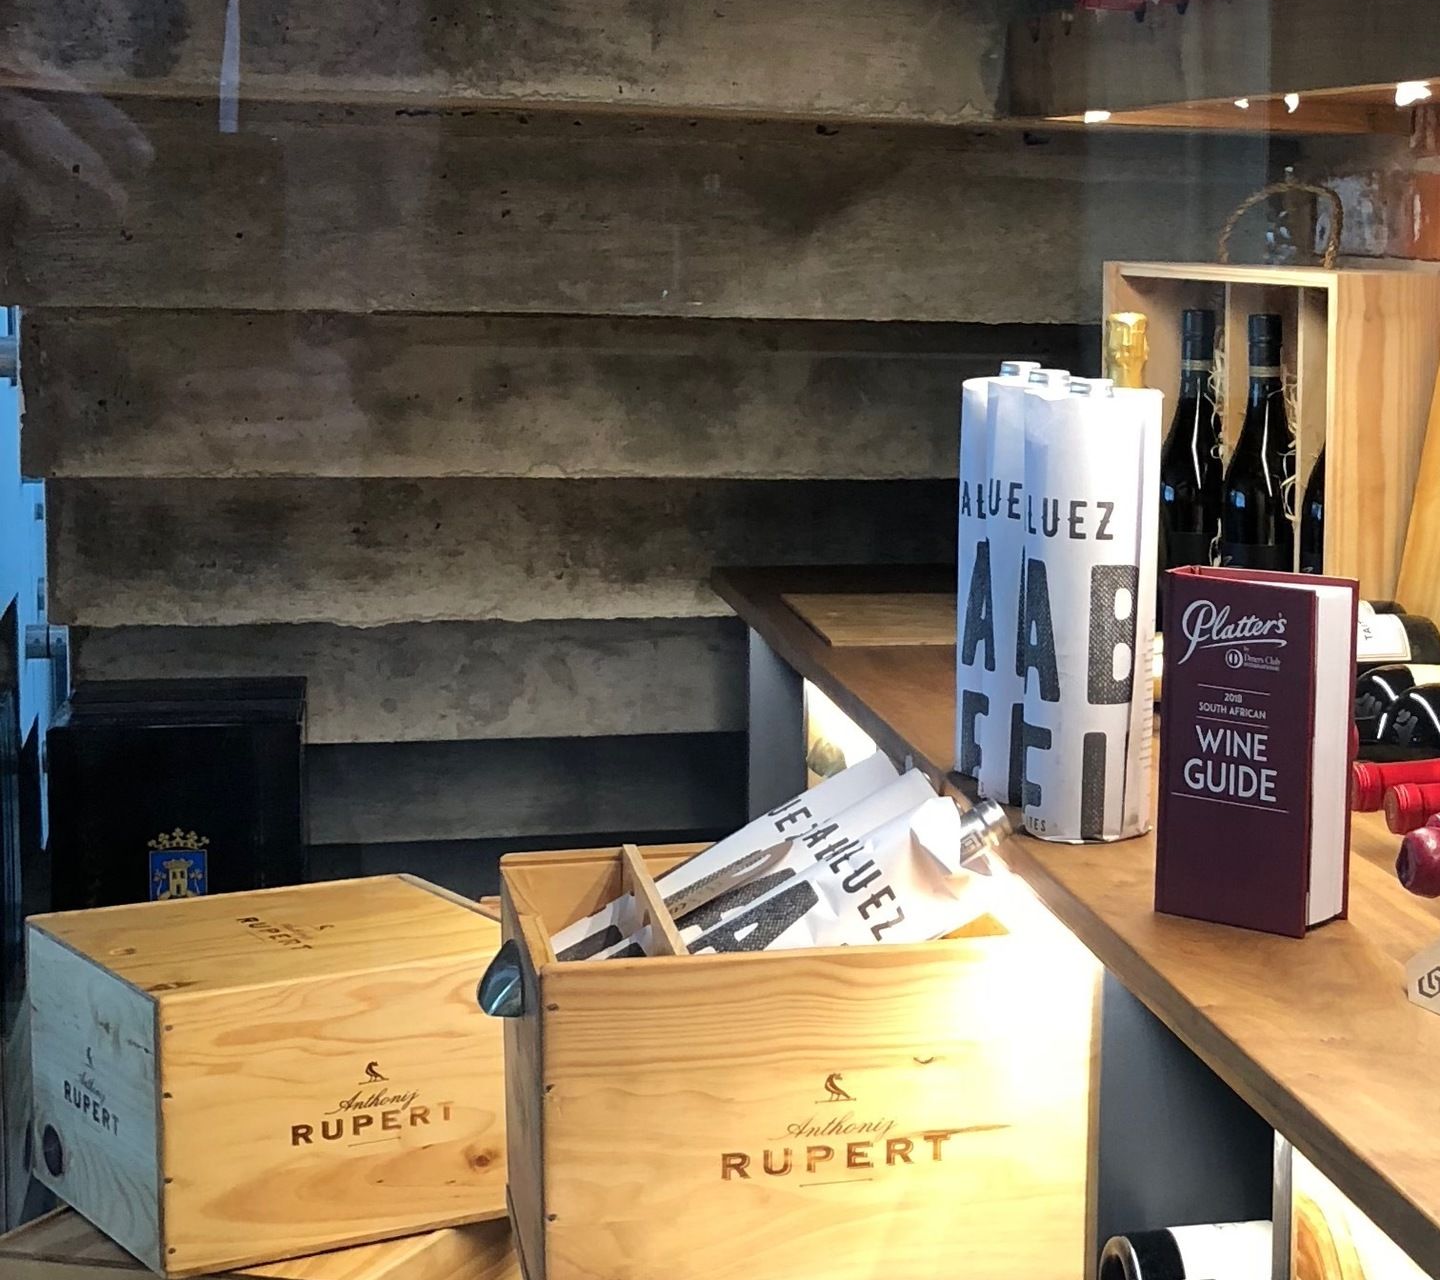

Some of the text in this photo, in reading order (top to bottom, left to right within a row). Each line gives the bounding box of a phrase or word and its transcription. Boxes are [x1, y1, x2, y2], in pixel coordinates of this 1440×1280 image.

[1178, 599, 1288, 665] Platter's
[1198, 702, 1267, 720] SOUTH AFRICAN
[1195, 724, 1269, 762] WINE
[1183, 757, 1278, 802] GUIDE
[236, 916, 313, 951] RUPERT
[64, 1080, 119, 1137] RUPERT
[291, 1101, 454, 1146] RUPERT
[720, 1131, 953, 1181] RUPERT
